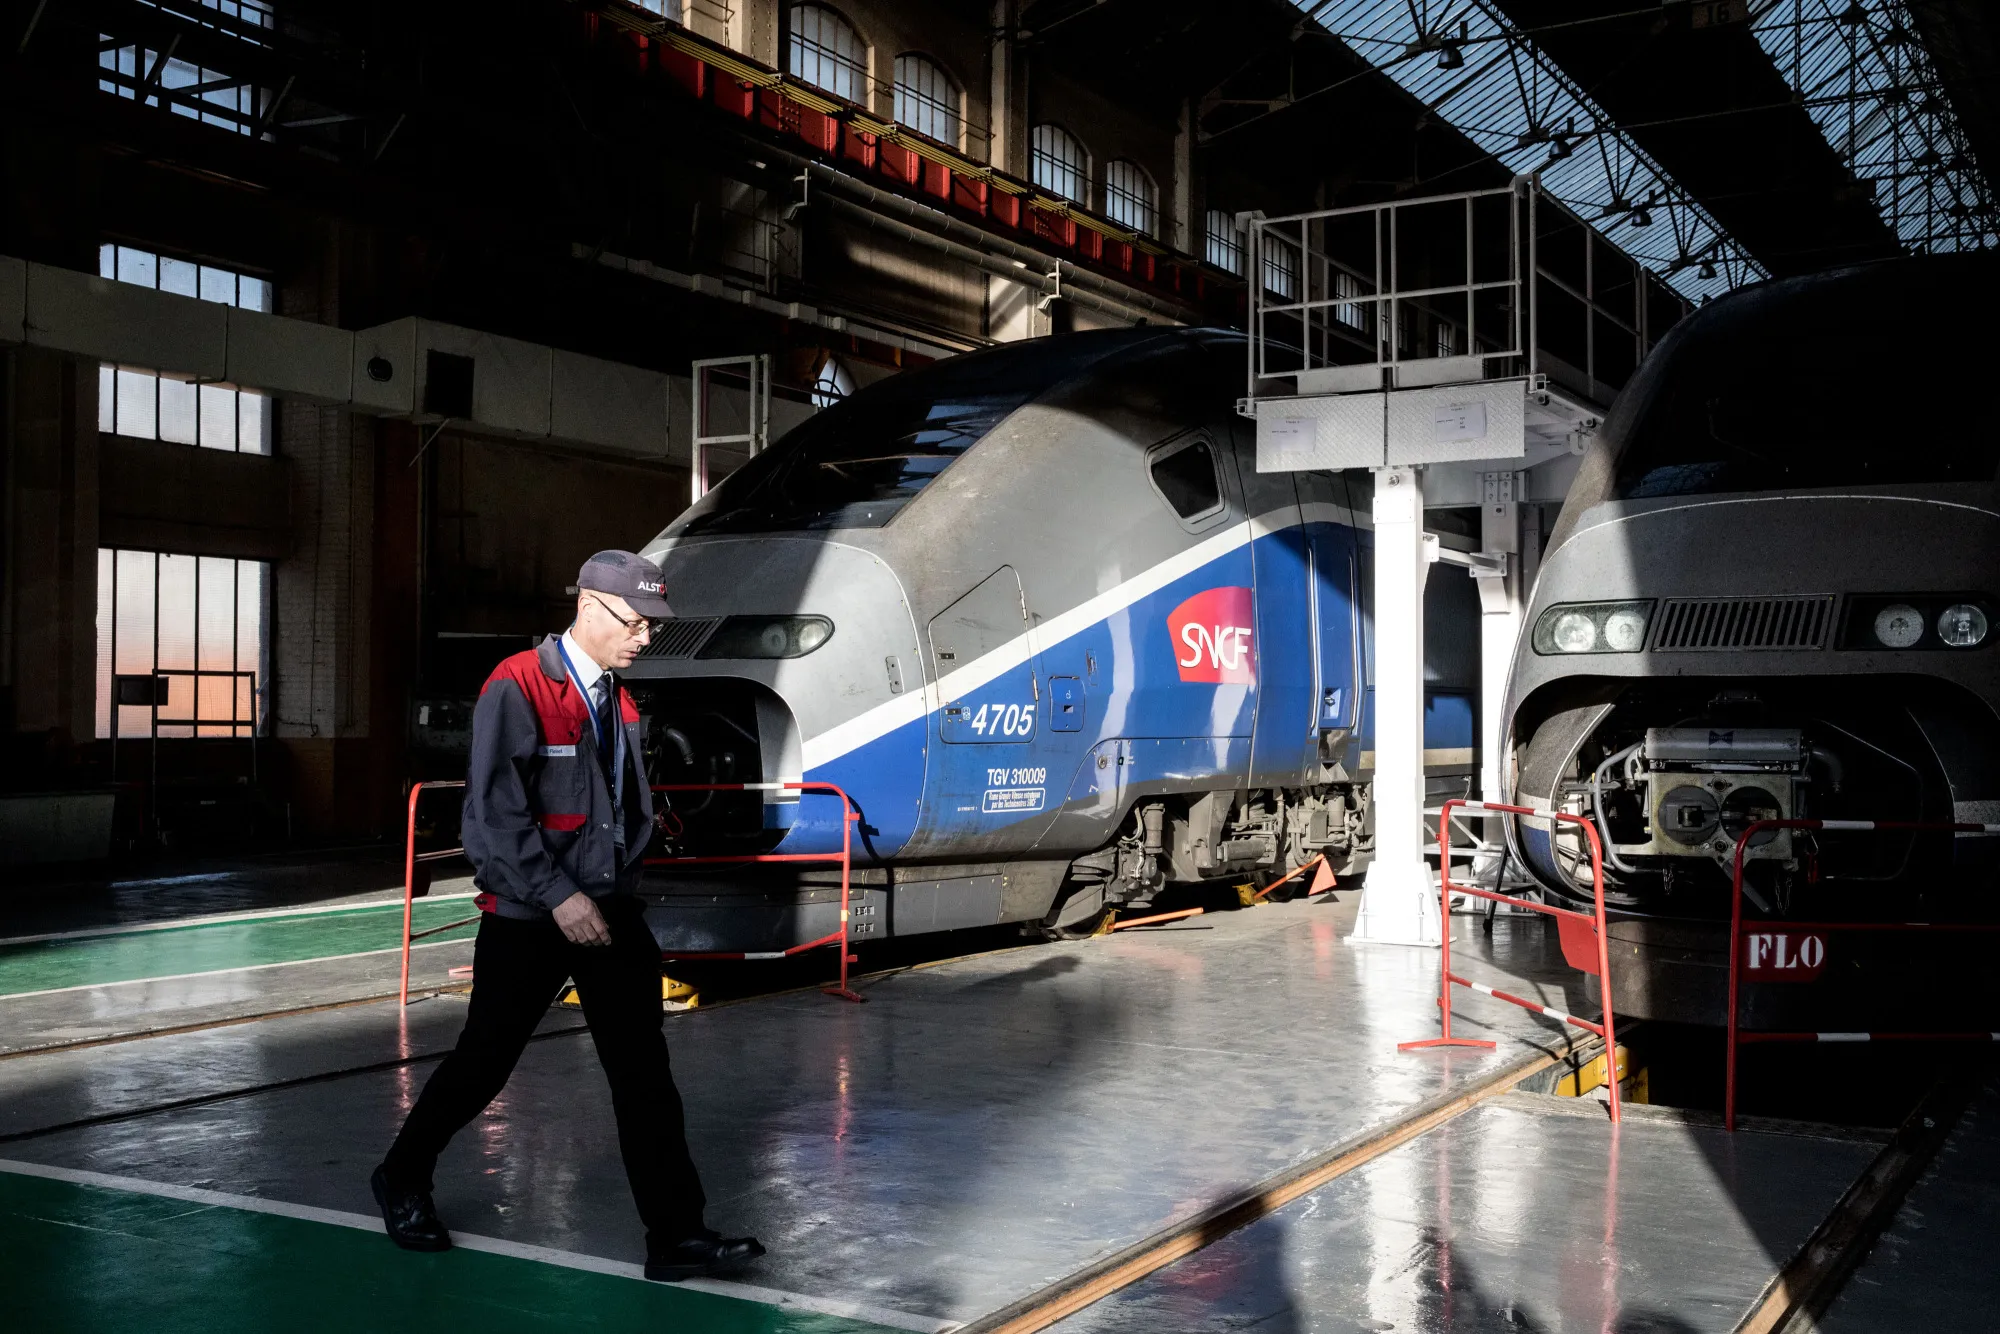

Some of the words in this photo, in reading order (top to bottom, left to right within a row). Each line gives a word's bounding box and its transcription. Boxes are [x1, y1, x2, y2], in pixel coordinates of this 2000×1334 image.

[637, 580, 667, 594] ALSTO
[1180, 622, 1252, 670] SNCF
[971, 703, 1035, 736] 4705
[987, 768, 1010, 786] TGV
[1011, 767, 1046, 785] 310009
[1748, 934, 1824, 969] FLO
